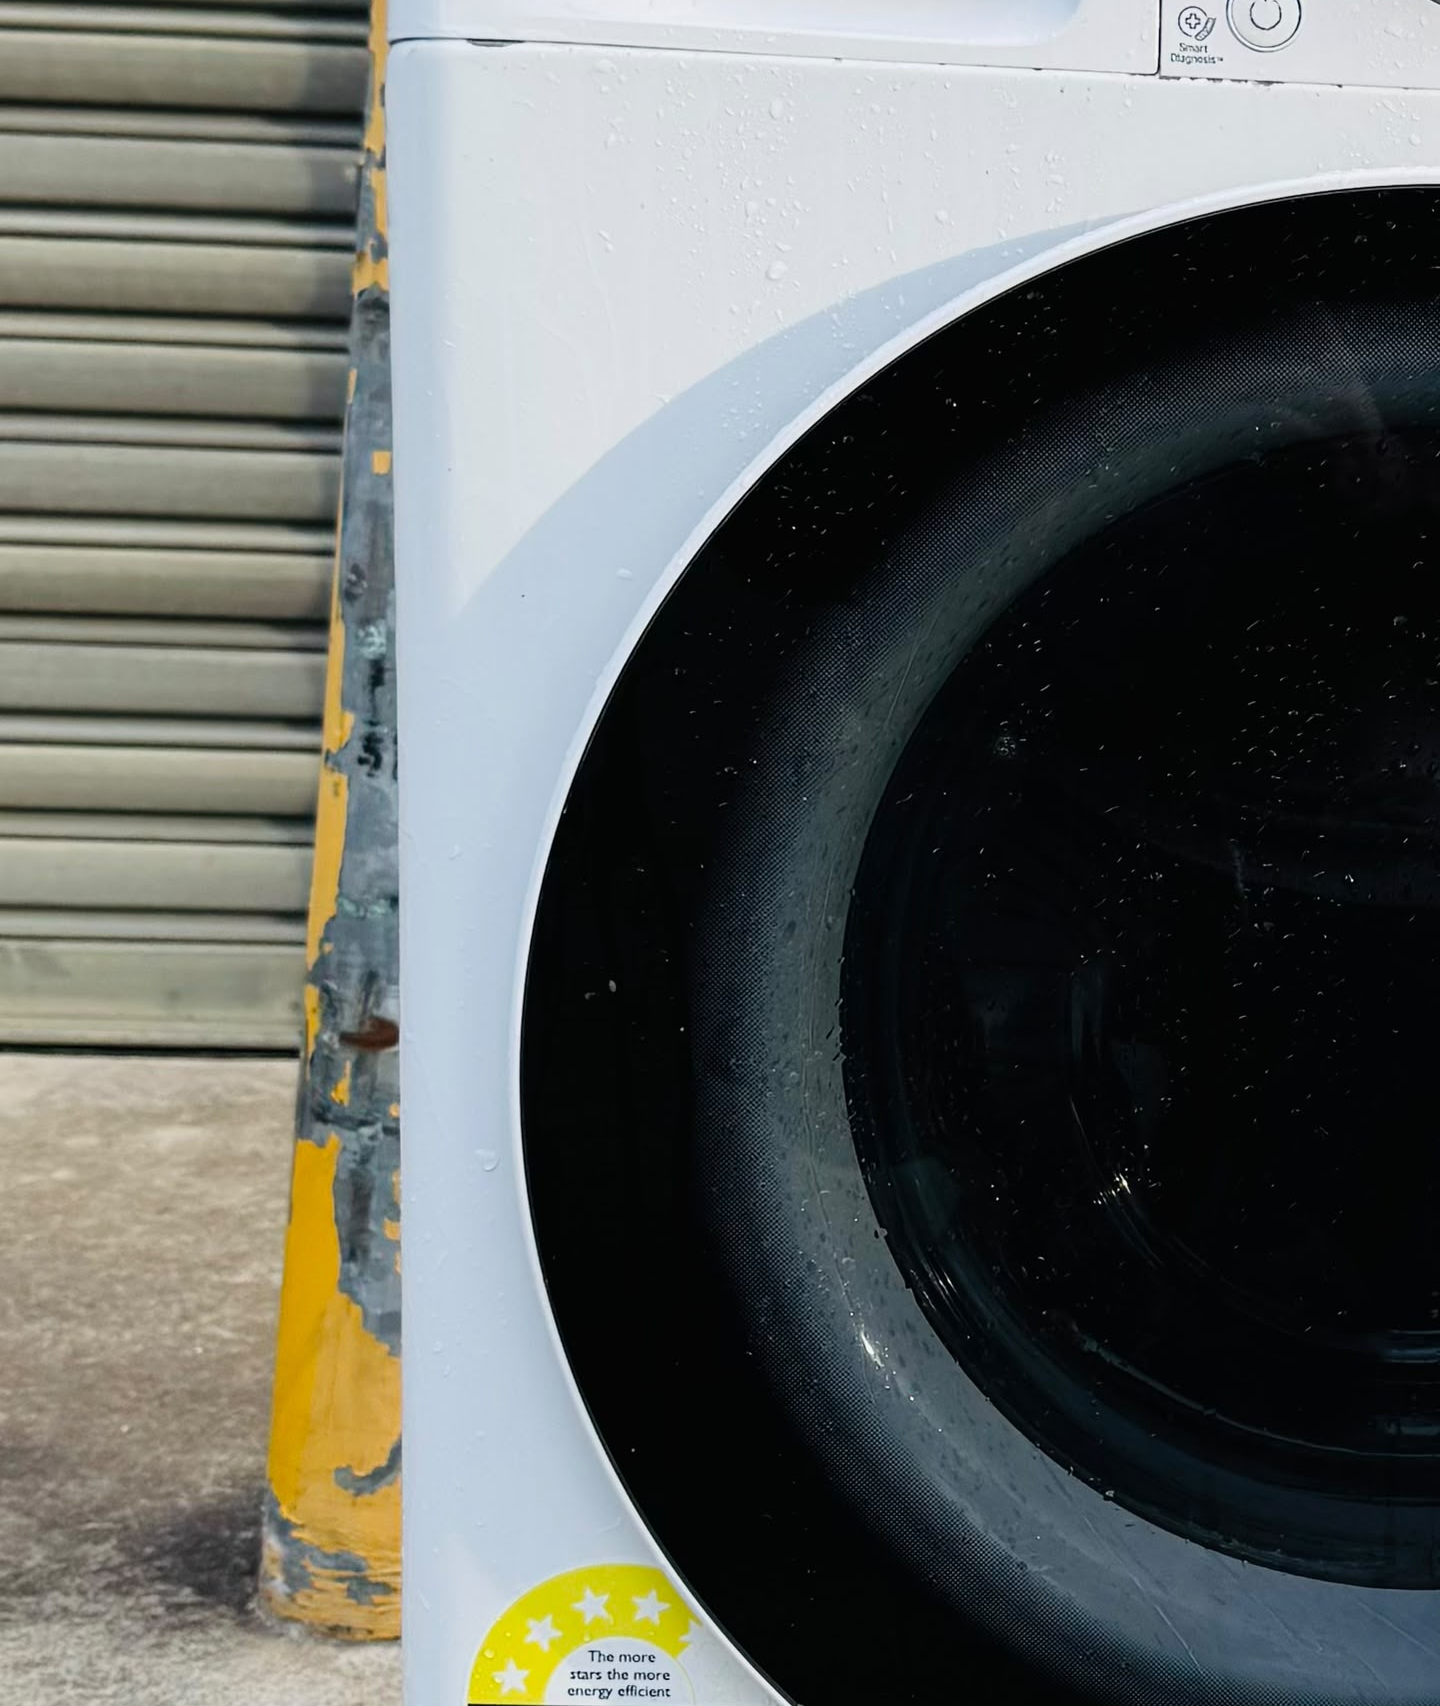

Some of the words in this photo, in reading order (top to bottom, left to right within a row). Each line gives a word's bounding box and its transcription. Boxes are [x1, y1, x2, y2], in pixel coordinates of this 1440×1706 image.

[1178, 43, 1208, 53] Smart
[587, 1650, 615, 1663] The
[618, 1653, 657, 1664] more
[569, 1669, 603, 1681] stars
[606, 1669, 630, 1681] the
[632, 1671, 671, 1682] more
[567, 1686, 614, 1700] energy
[617, 1686, 672, 1698] efficient
